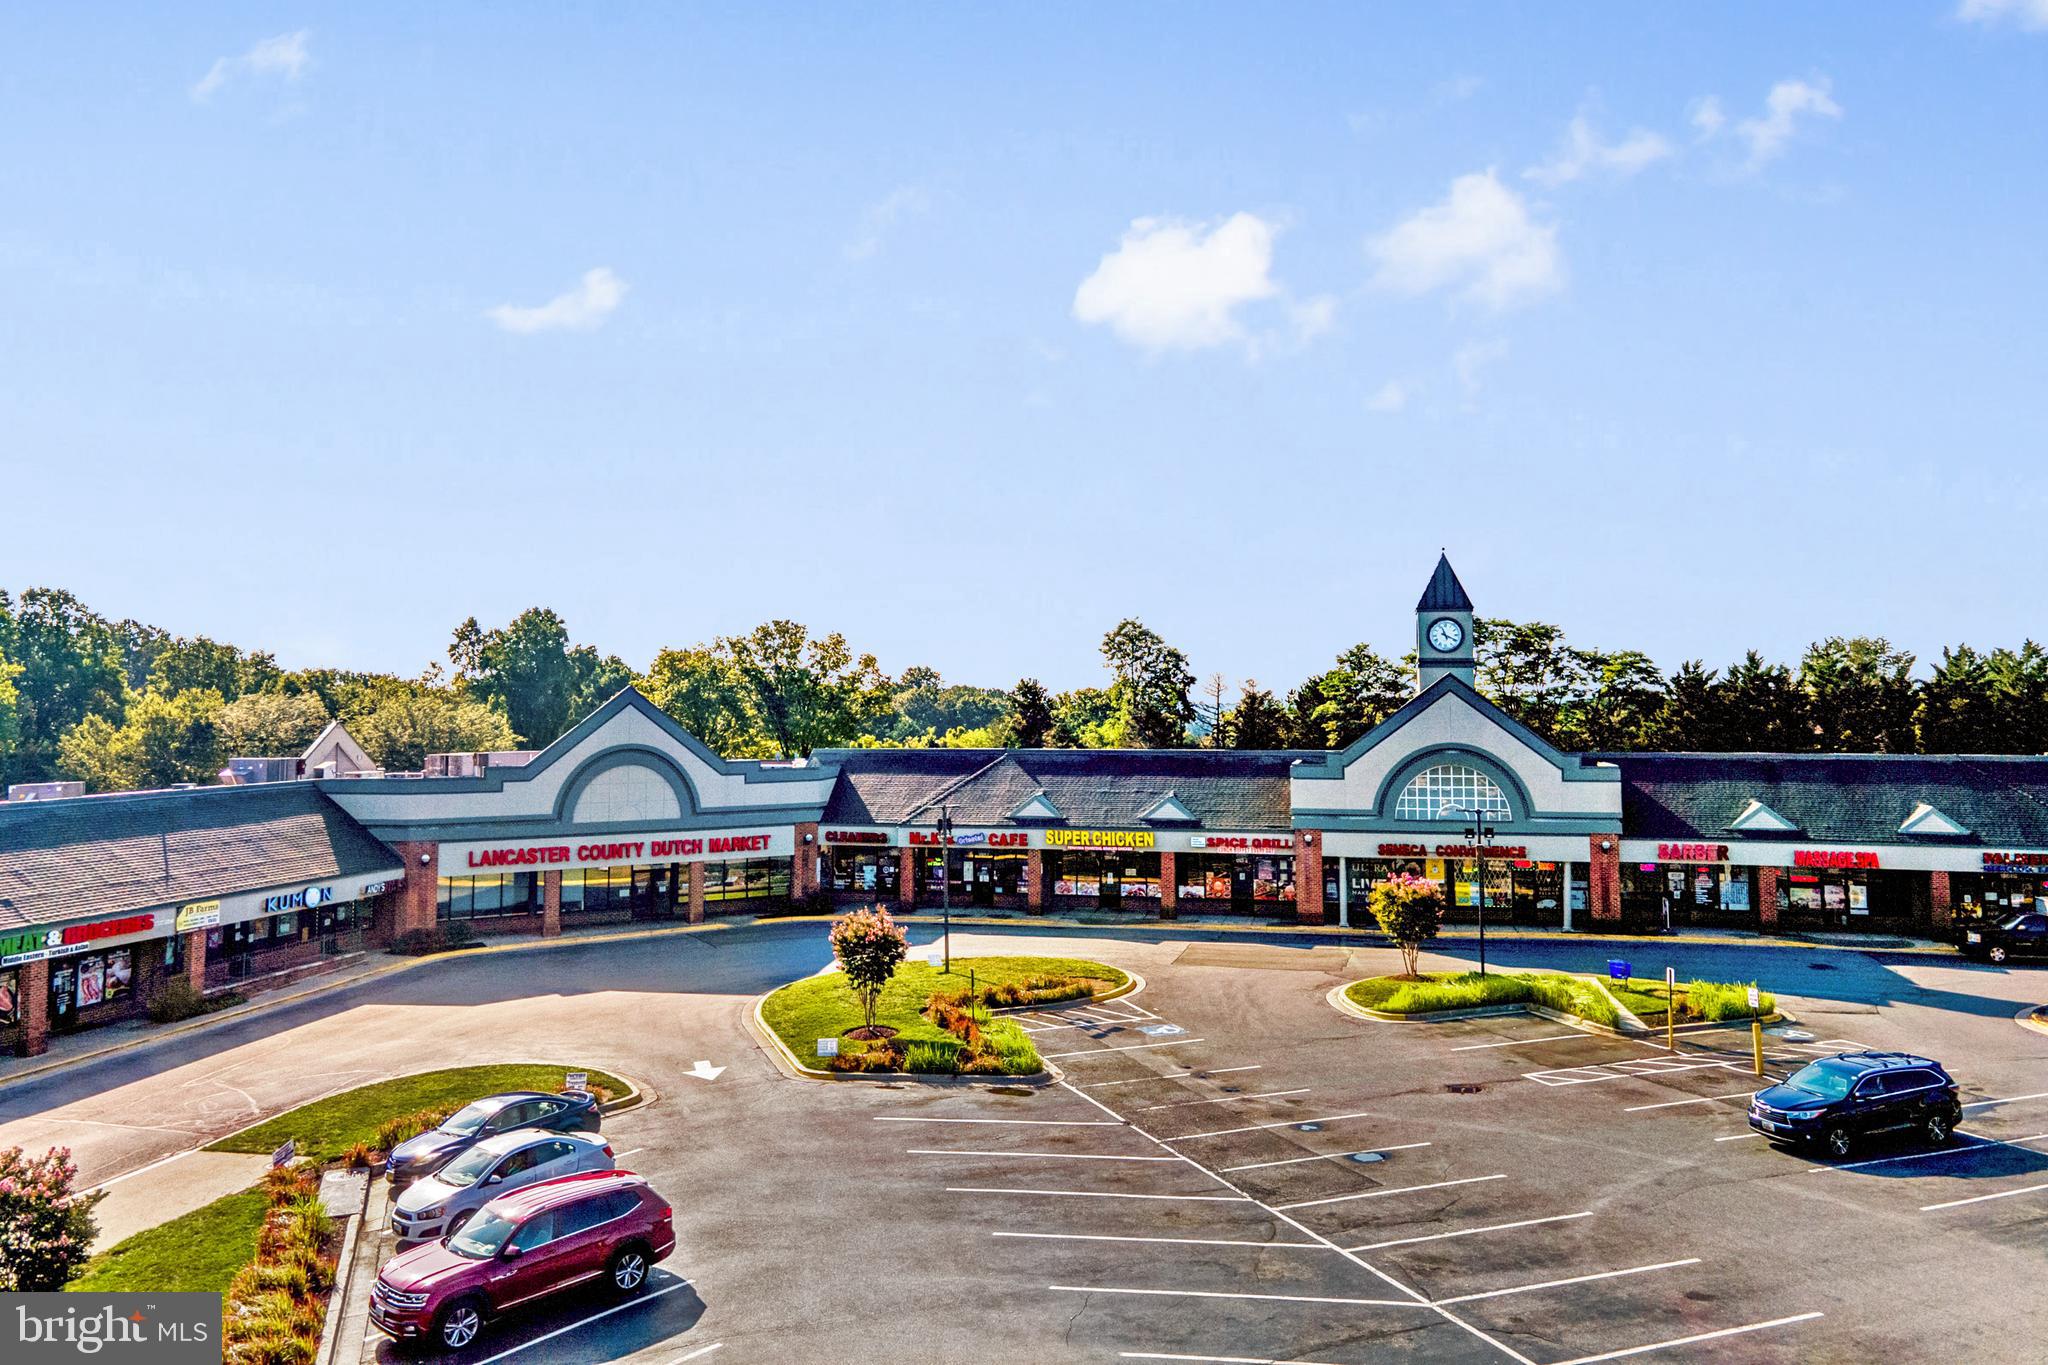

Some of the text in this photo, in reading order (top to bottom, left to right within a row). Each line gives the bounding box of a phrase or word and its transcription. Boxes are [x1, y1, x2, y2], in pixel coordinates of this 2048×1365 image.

[825, 831, 888, 844] CLEANERS
[988, 833, 1028, 847] CAFE
[1046, 830, 1154, 847] SUPER CHICKEN
[1206, 837, 1247, 848] SPICE
[468, 834, 771, 868] LANCASTER COUNTY DUTCH MARKET
[1378, 843, 1427, 857] SENECA
[1657, 844, 1730, 861] BARBER
[1794, 850, 1880, 868] MASSAGE SPA
[265, 887, 332, 912] KUMON
[46, 930, 62, 946] &
